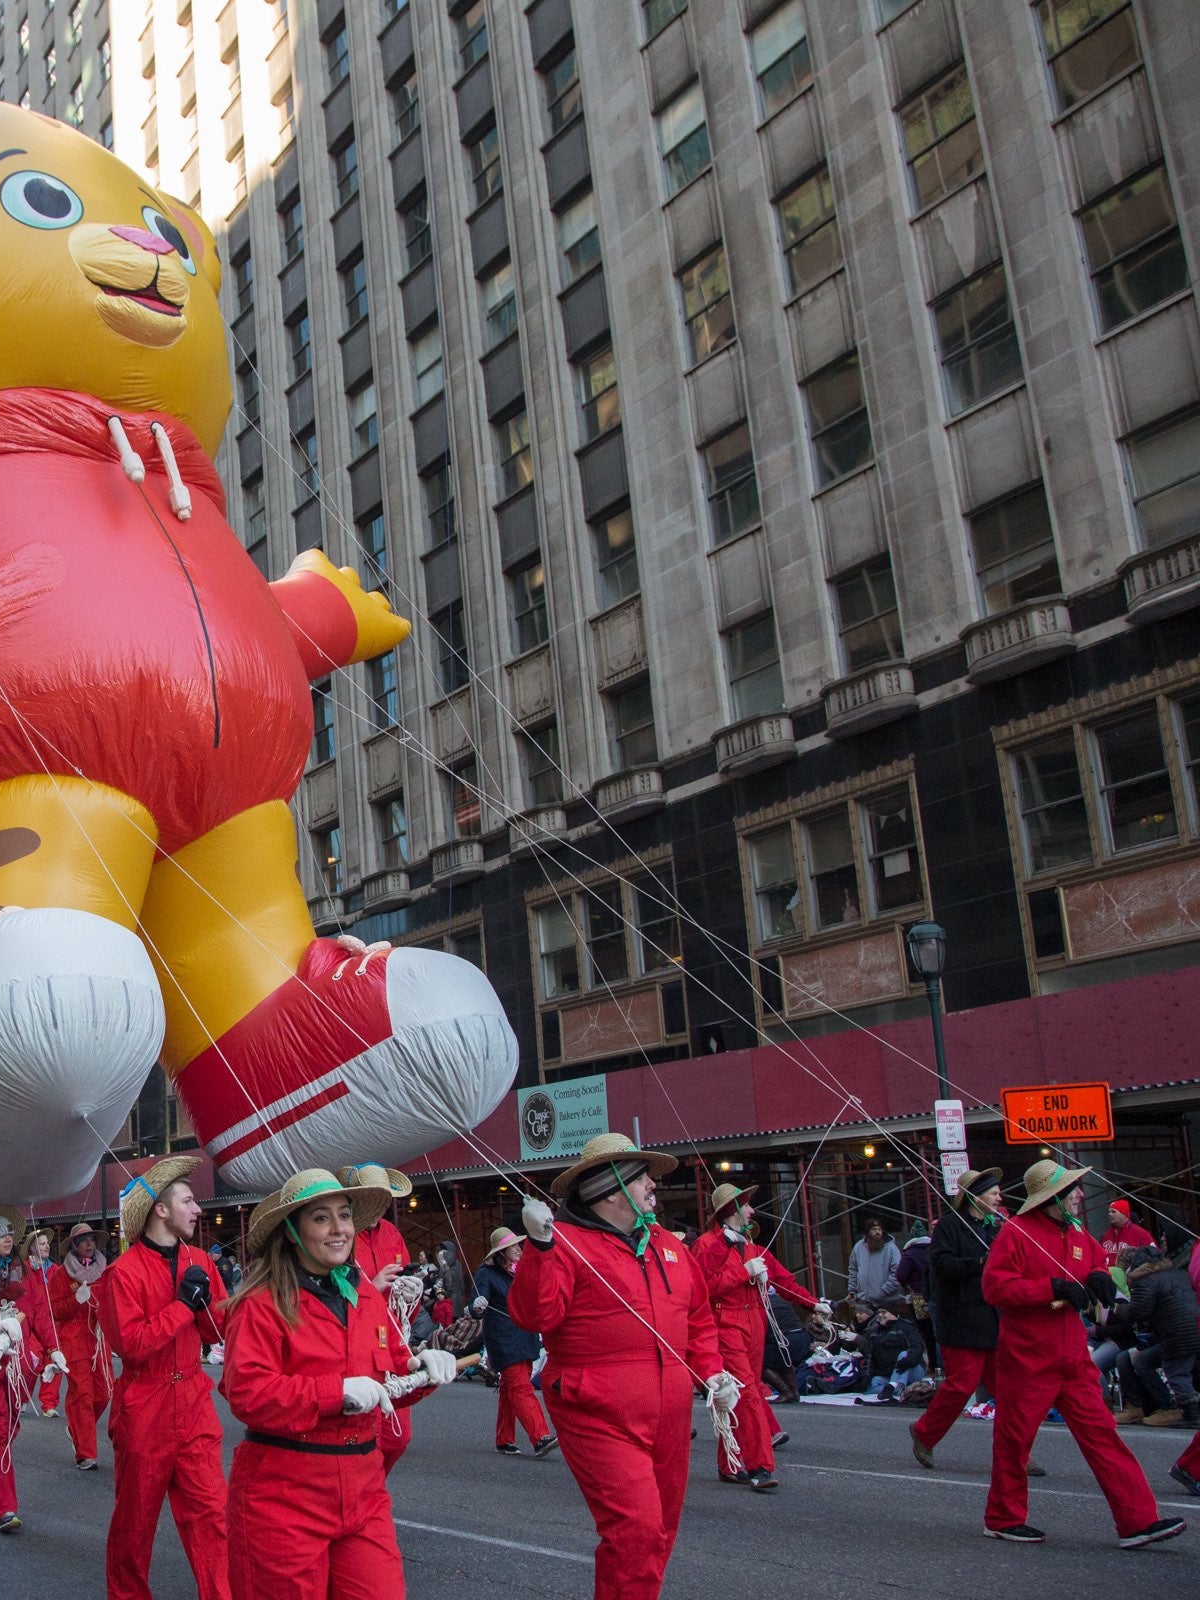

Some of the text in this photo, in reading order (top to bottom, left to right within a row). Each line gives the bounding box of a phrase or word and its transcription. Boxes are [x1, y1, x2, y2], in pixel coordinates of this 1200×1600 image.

[554, 1082, 604, 1100] Coming Soon!!
[1043, 1095, 1069, 1111] END
[527, 1109, 550, 1125] Classic
[559, 1105, 603, 1121] Bakery & Café
[531, 1120, 549, 1137] Cake
[1018, 1115, 1098, 1133] ROAD WORK
[561, 1139, 590, 1150] 888-404-
